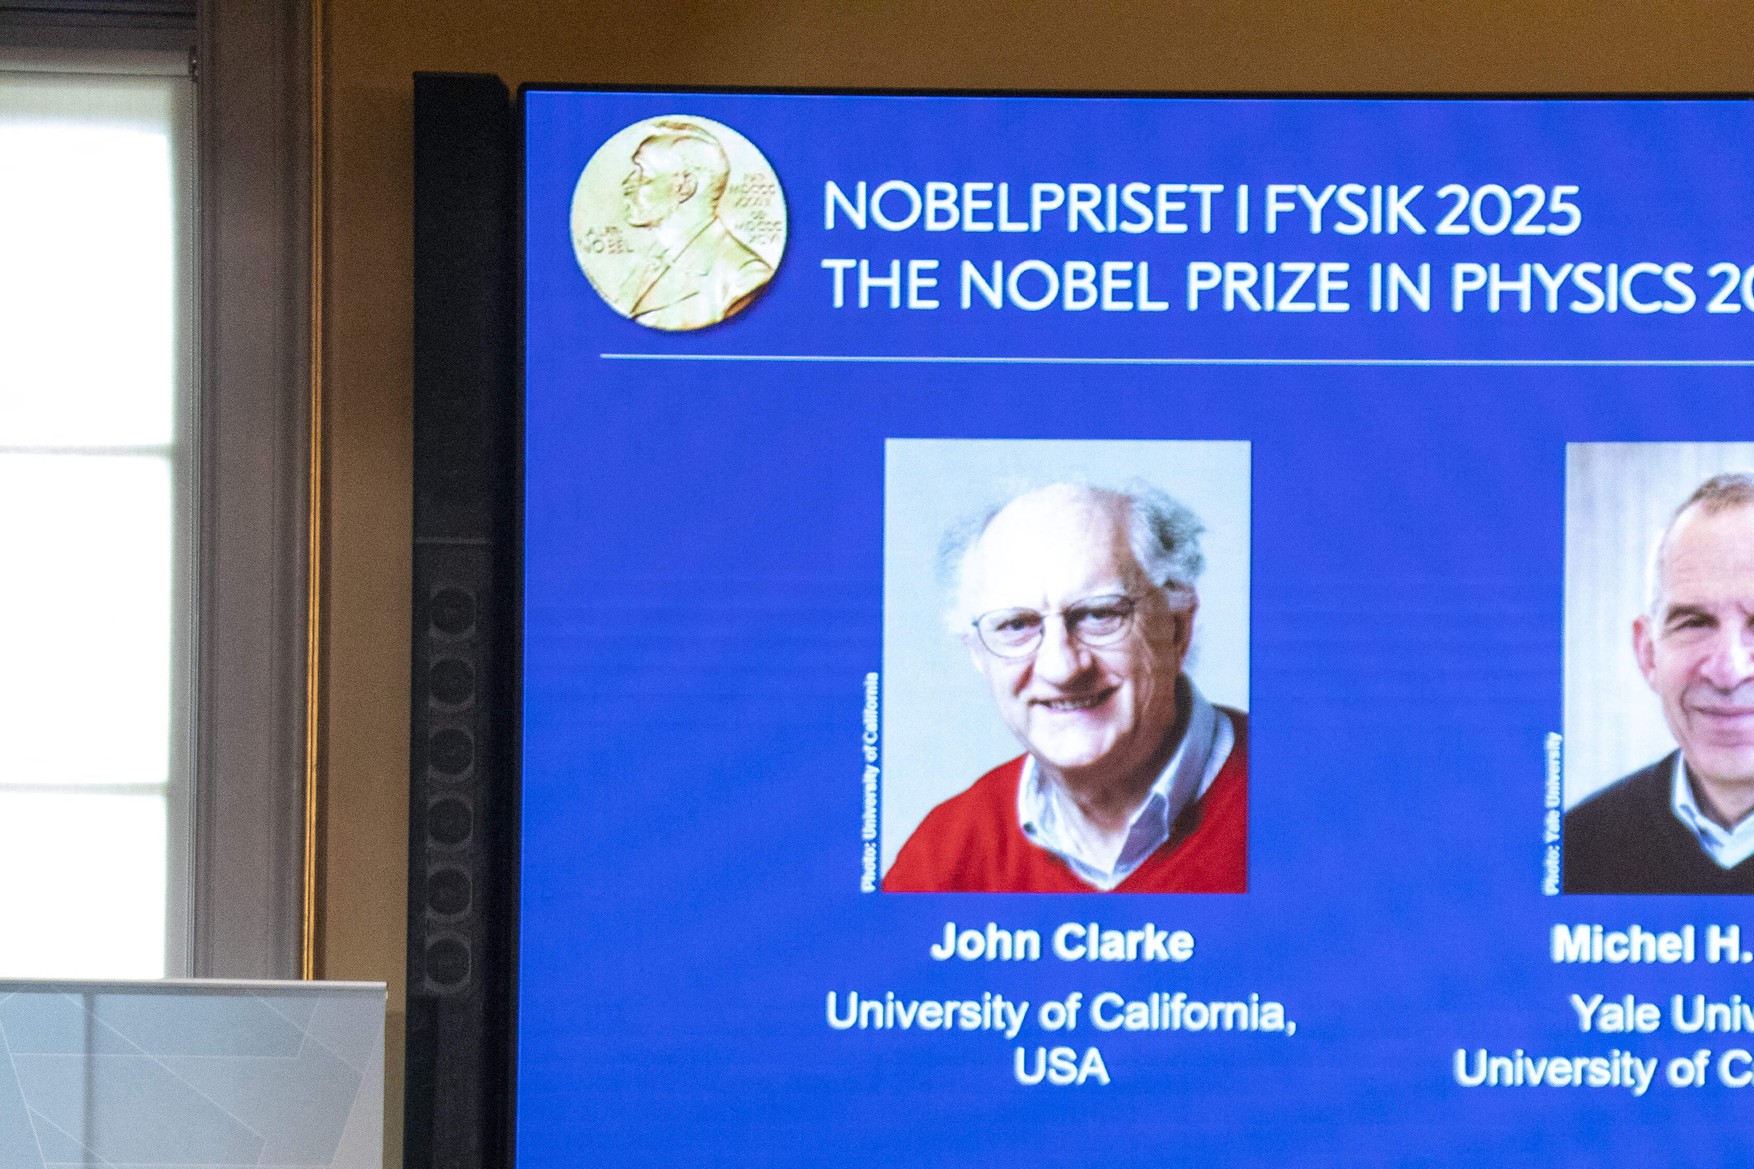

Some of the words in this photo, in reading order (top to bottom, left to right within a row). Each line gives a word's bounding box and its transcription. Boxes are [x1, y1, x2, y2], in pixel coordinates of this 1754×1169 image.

[824, 179, 1225, 235] NOBELPRISET
[1237, 183, 1249, 234] I
[1265, 182, 1428, 236] FYSIK
[1435, 182, 1582, 237] 2025
[820, 257, 941, 310] THE
[960, 258, 1170, 312] NOBEL
[1187, 260, 1351, 313] PRIZE
[1370, 261, 1431, 313] IN
[1452, 261, 1697, 315] PHYSICS
[862, 672, 880, 745] California
[862, 745, 879, 763] of
[1545, 732, 1563, 809] University
[862, 763, 880, 841] University
[1545, 809, 1561, 844] Yale
[860, 841, 877, 893] Photo:
[1542, 845, 1561, 897] Photo:
[929, 921, 1041, 961] John
[1052, 921, 1195, 962] Clarke
[1551, 923, 1696, 964] Michel
[1706, 924, 1754, 965] H.
[826, 990, 1030, 1040] University
[1038, 991, 1084, 1031] of
[1090, 991, 1297, 1037] California,
[1570, 992, 1662, 1033] Yale
[1014, 1046, 1112, 1085] USA
[1455, 1047, 1659, 1097] University
[1667, 1048, 1713, 1088] of
